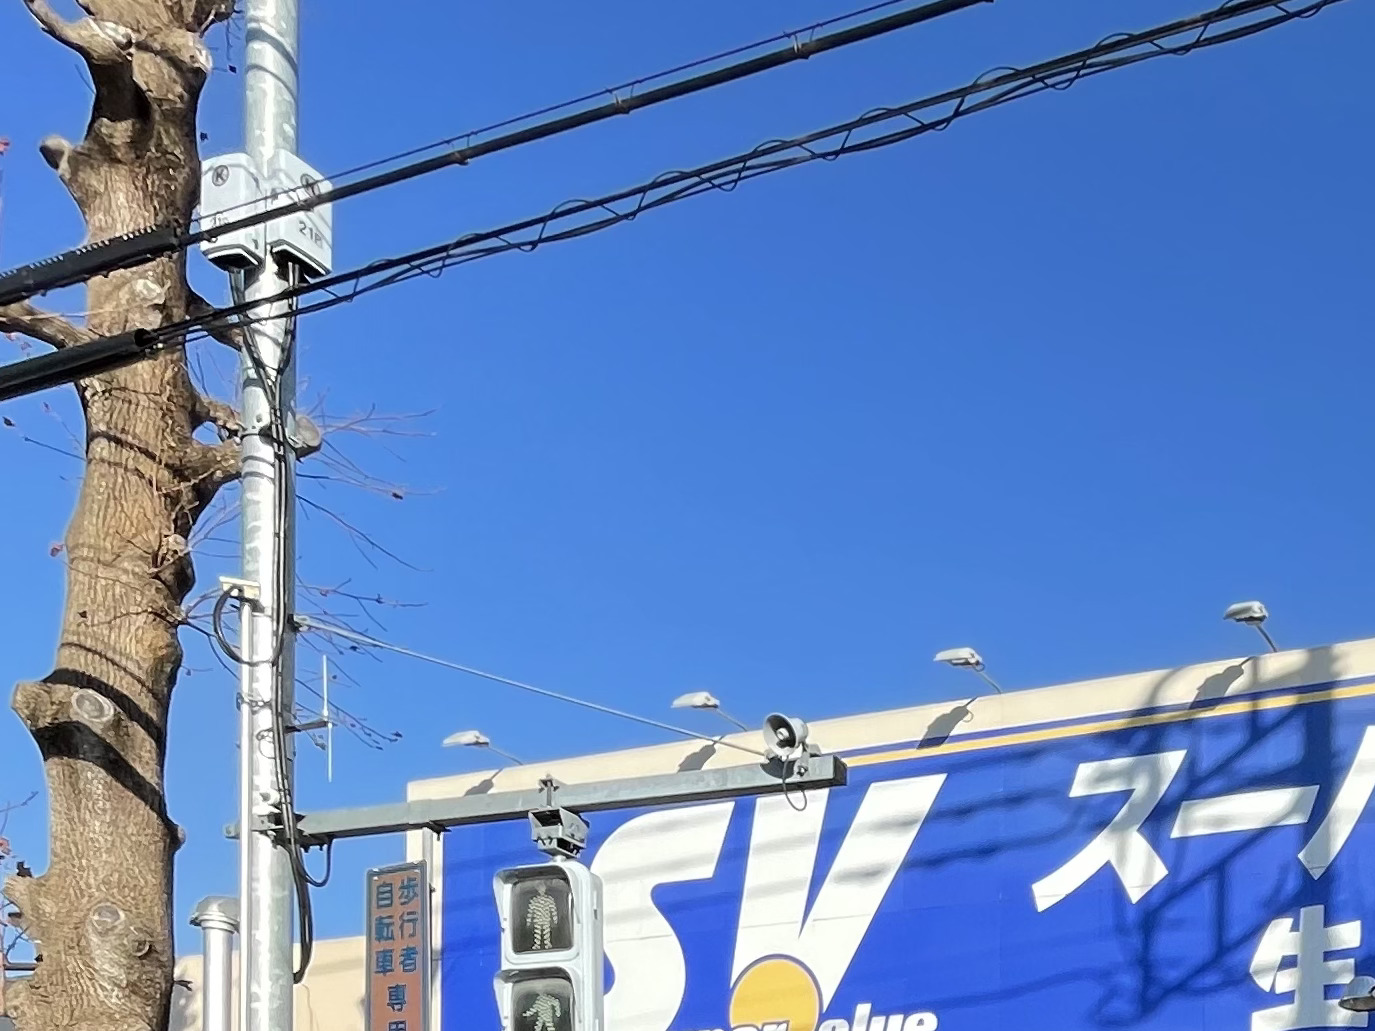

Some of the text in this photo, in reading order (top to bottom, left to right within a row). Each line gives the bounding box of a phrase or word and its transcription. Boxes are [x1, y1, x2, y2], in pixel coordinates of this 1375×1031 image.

[374, 881, 395, 977] 自転車
[398, 877, 418, 973] 歩行者
